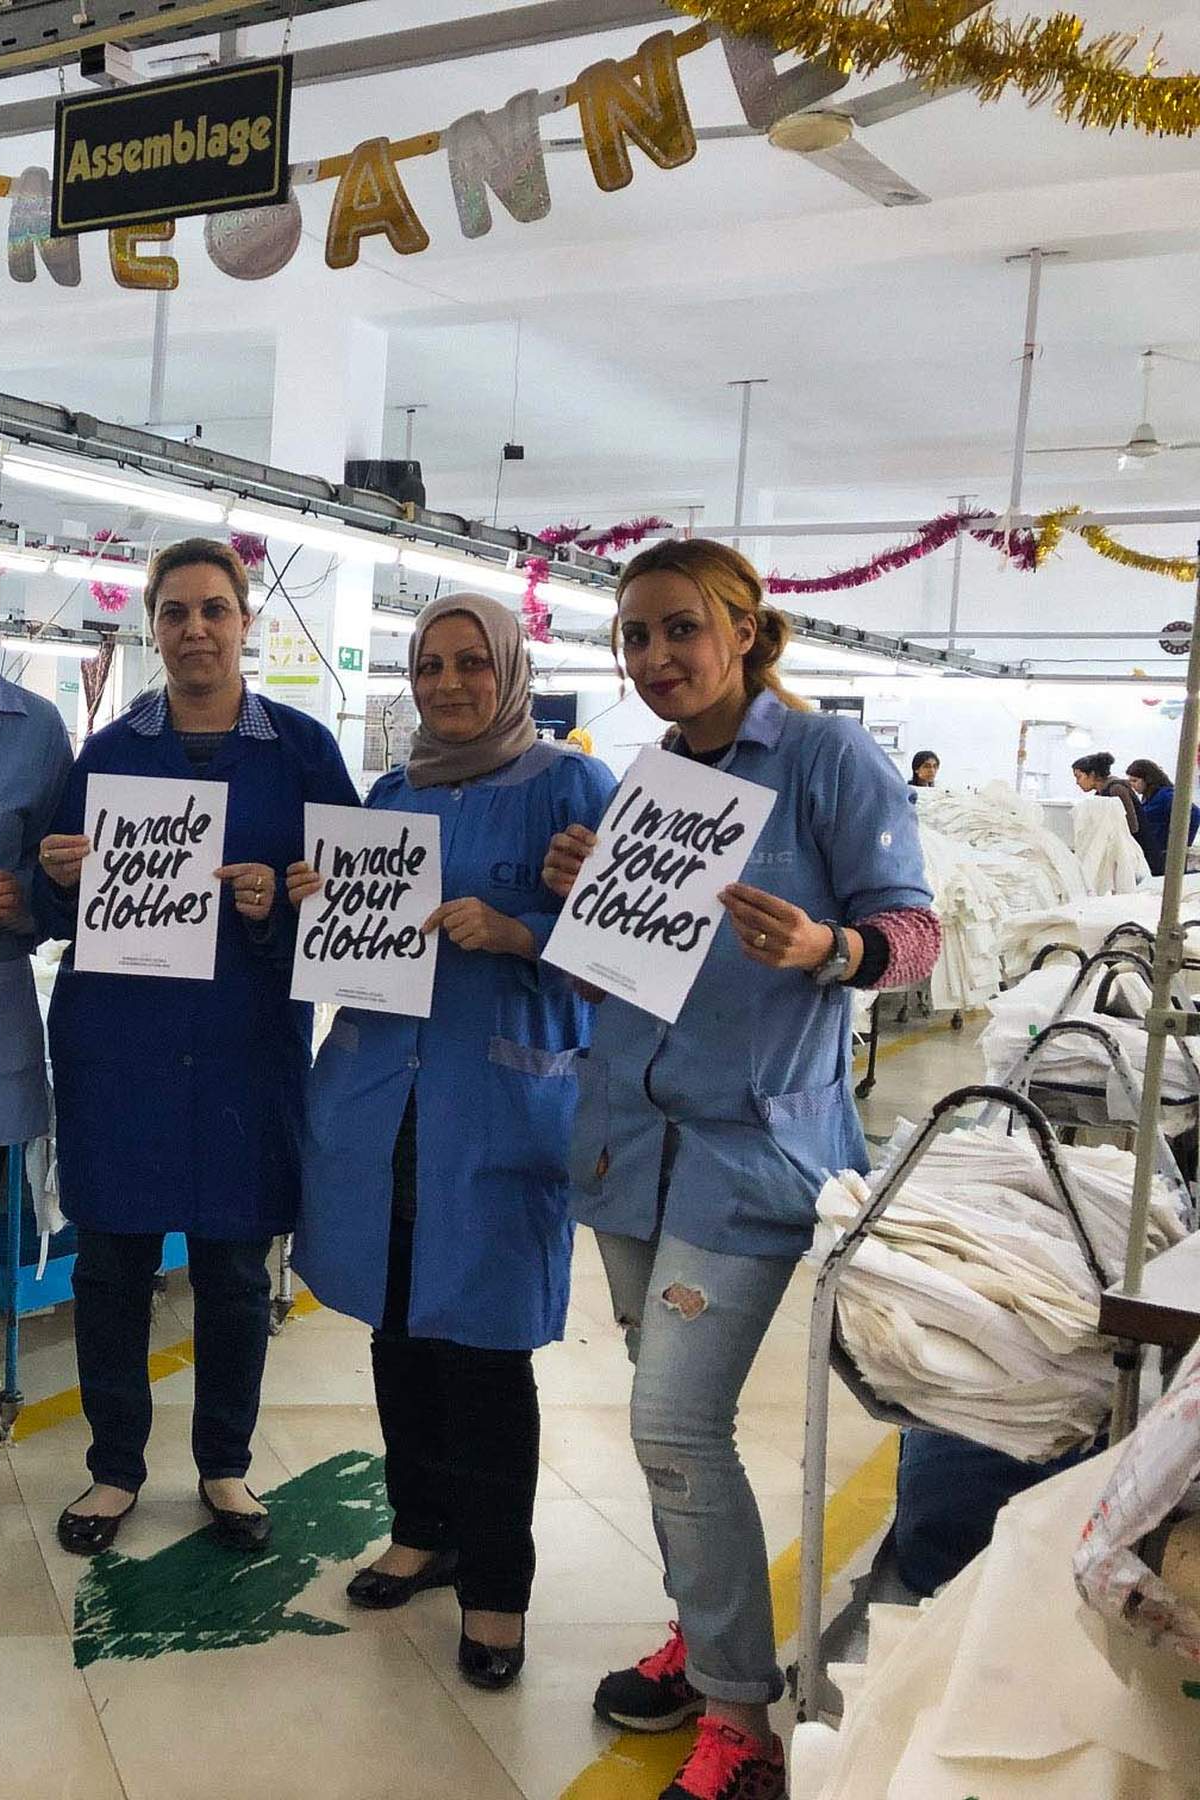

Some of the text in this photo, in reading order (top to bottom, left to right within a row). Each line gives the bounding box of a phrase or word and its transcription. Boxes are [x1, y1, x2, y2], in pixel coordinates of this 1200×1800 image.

[65, 114, 272, 184] Assemblage
[94, 794, 212, 853] I made
[611, 786, 745, 856] I made
[97, 849, 193, 895] your
[313, 826, 427, 878] I made
[597, 834, 707, 890] your
[84, 883, 213, 932] clothes
[316, 878, 413, 924] your
[572, 876, 711, 953] clothes
[303, 913, 427, 963] clothes
